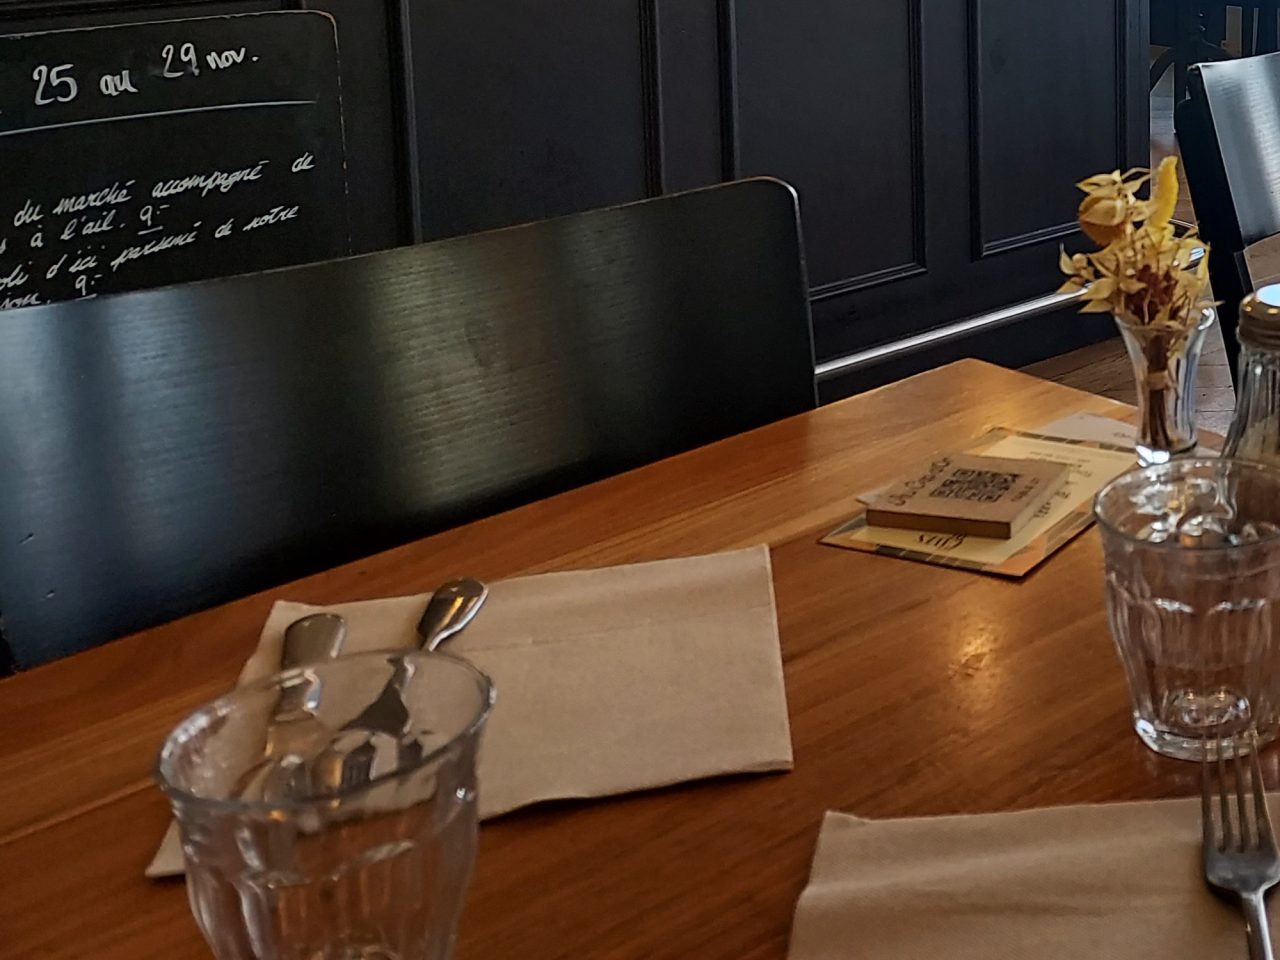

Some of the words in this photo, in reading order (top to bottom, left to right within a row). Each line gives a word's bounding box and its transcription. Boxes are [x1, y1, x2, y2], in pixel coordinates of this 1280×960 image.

[32, 63, 78, 107] 25
[100, 68, 139, 97] au
[161, 43, 200, 79] 29
[206, 46, 260, 71] nov.
[14, 197, 44, 227] du
[53, 179, 136, 216] marché
[152, 160, 270, 198] accompagné
[291, 151, 316, 173] de
[30, 224, 44, 249] à
[214, 218, 235, 239] de
[242, 205, 300, 232] notre
